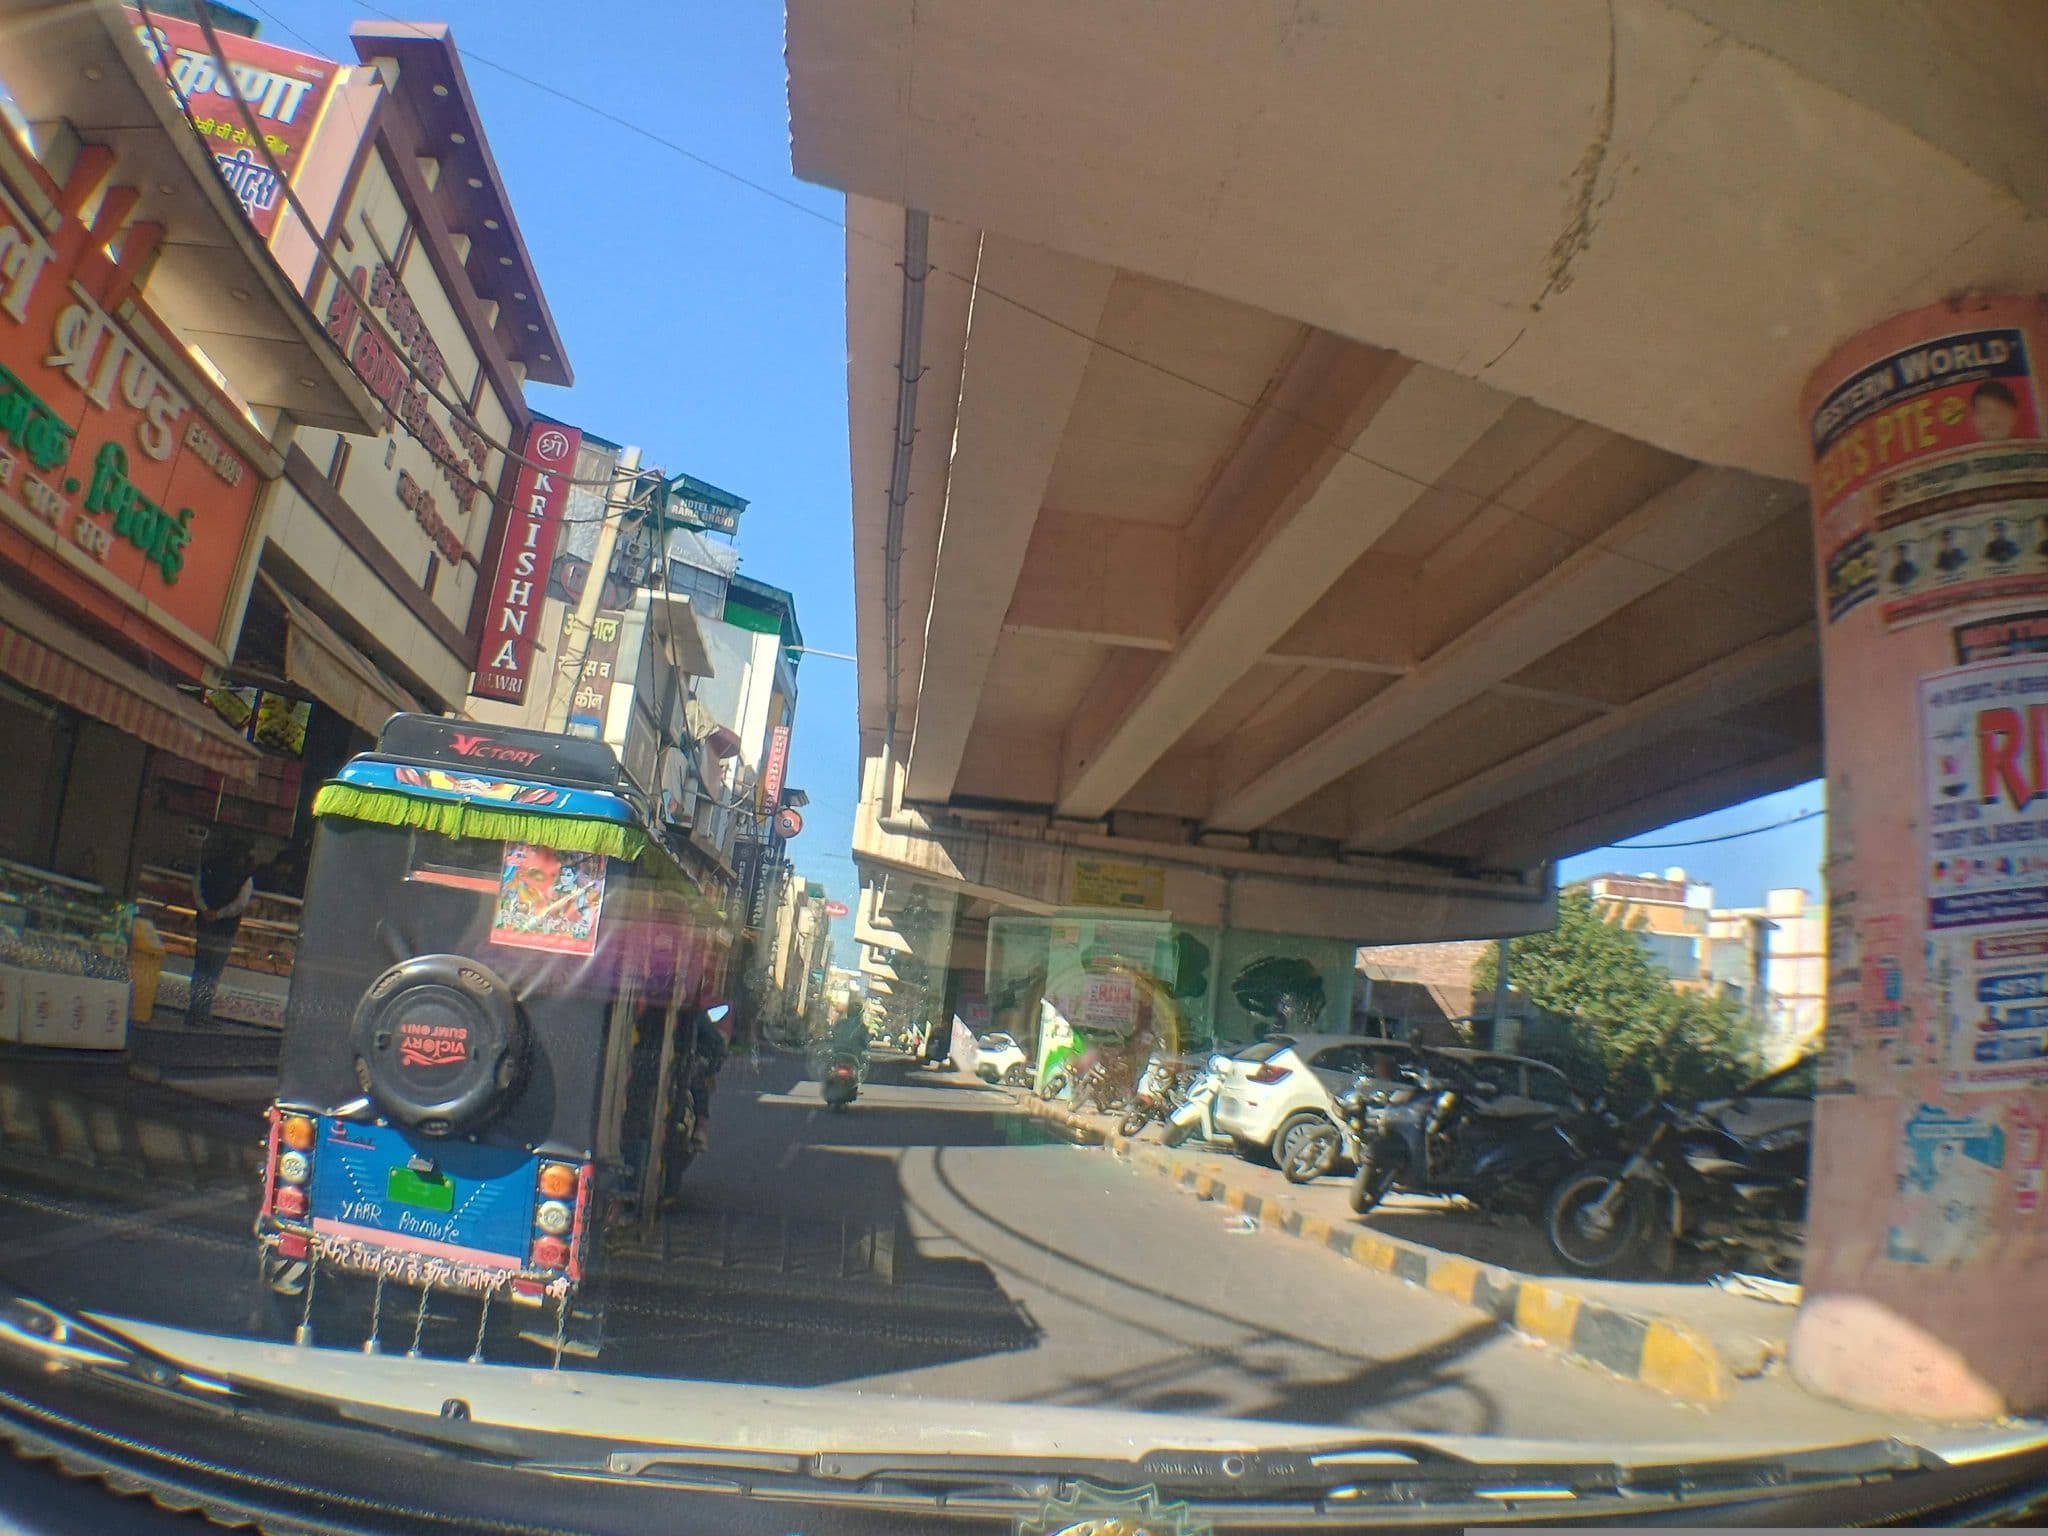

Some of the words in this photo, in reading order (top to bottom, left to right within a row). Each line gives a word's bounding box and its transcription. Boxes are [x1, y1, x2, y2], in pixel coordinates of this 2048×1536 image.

[1901, 337, 2011, 384] WORLD
[1876, 399, 1937, 463] PTE
[490, 468, 554, 671] KRISHNA
[449, 732, 543, 767] VICTORY
[401, 1037, 466, 1058] VICTORY
